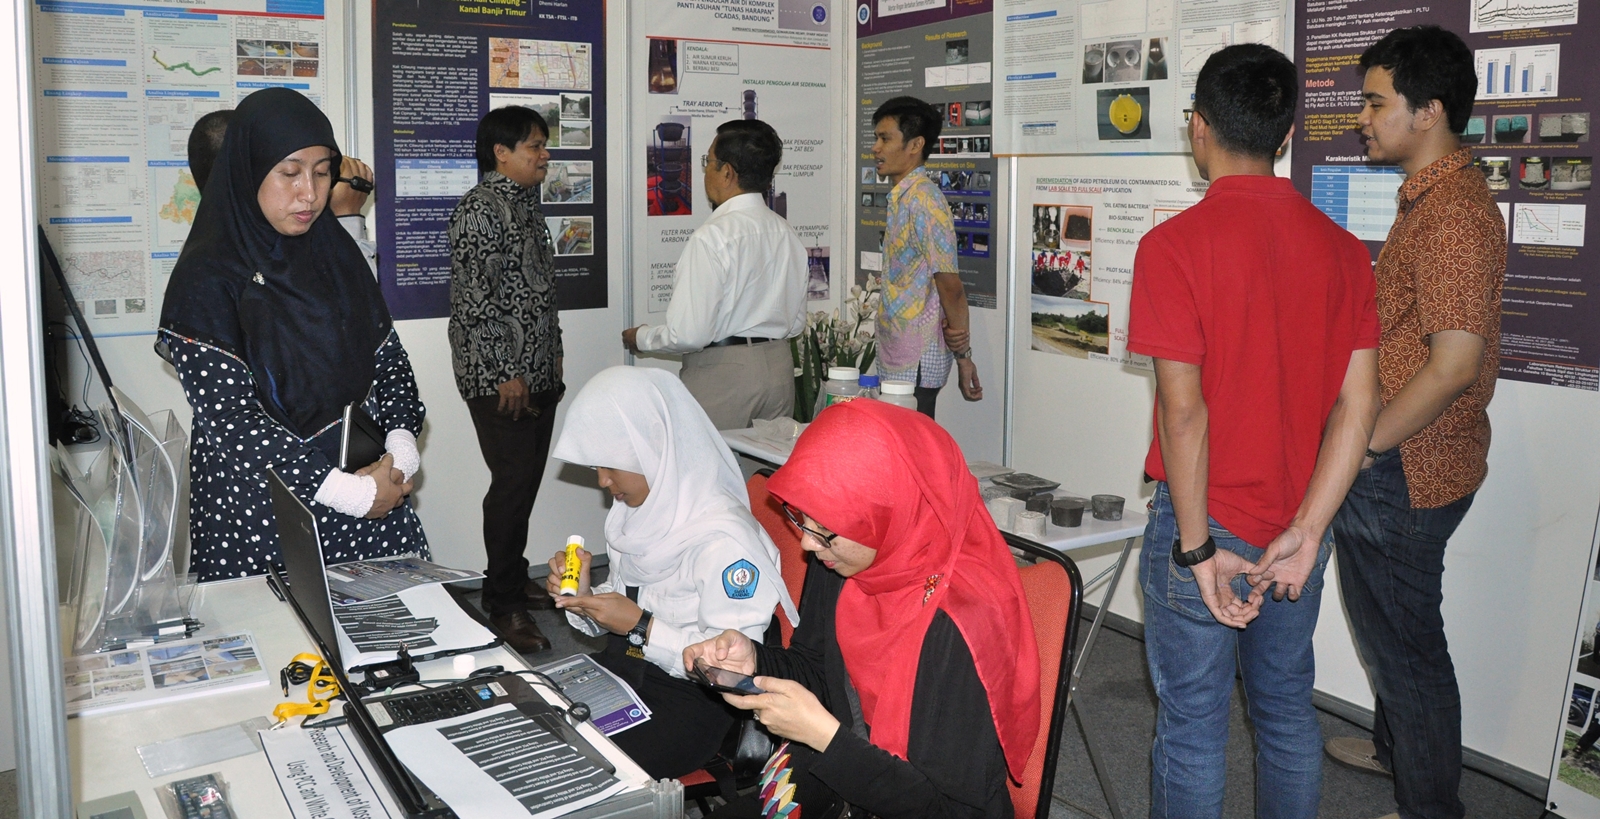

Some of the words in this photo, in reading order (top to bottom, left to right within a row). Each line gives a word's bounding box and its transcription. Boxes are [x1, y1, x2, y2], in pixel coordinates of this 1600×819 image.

[482, 7, 502, 16] Banjir
[925, 33, 941, 41] Results
[947, 31, 967, 39] Research
[1318, 38, 1353, 46] mengembangkan
[1306, 79, 1334, 88] Metode
[320, 752, 344, 763] and
[287, 760, 309, 778] Using
[294, 775, 317, 789] PCC
[326, 761, 361, 800] Development
[299, 787, 324, 800] and
